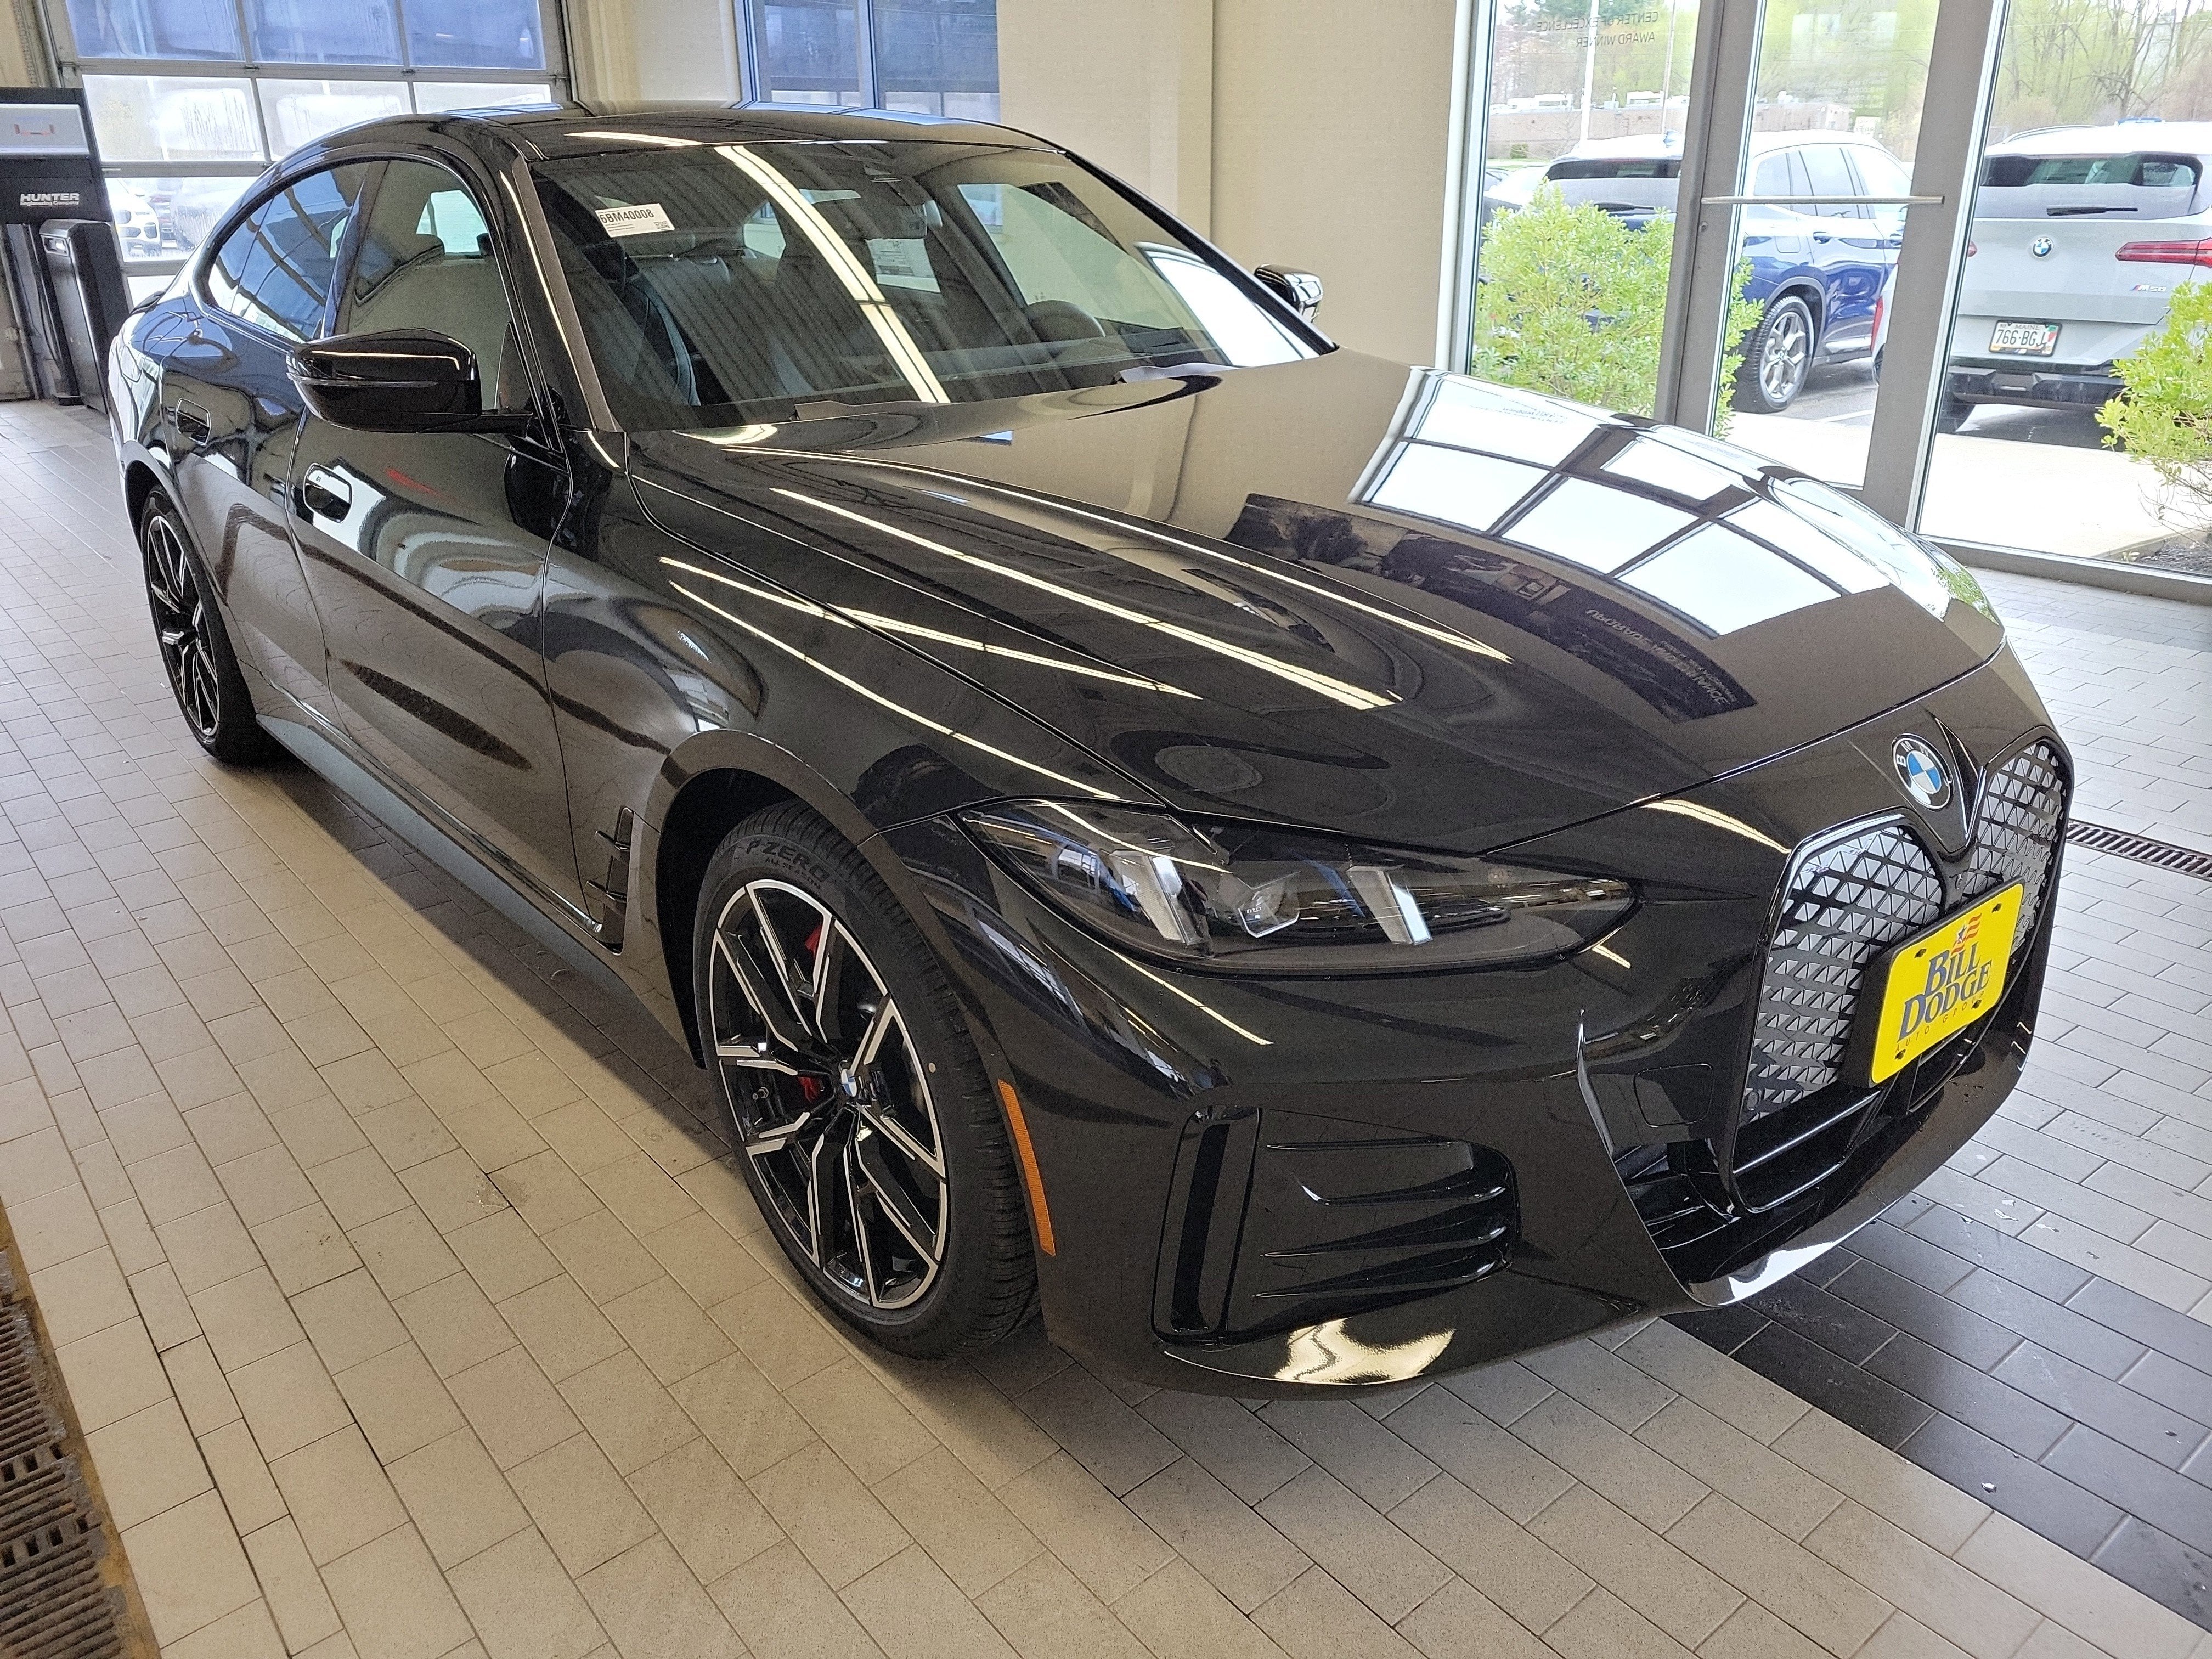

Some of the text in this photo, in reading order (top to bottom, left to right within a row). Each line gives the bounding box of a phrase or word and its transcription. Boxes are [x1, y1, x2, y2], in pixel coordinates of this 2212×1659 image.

[20, 193, 80, 201] HUNTER
[599, 208, 654, 223] 6BM40008
[2138, 284, 2167, 293] M50
[1896, 740, 1929, 768] BMW
[765, 857, 822, 890] ALL SEASON
[1924, 941, 1982, 995] BILL
[1897, 960, 1993, 1043] DODGE
[1895, 1025, 1930, 1053] AUTO
